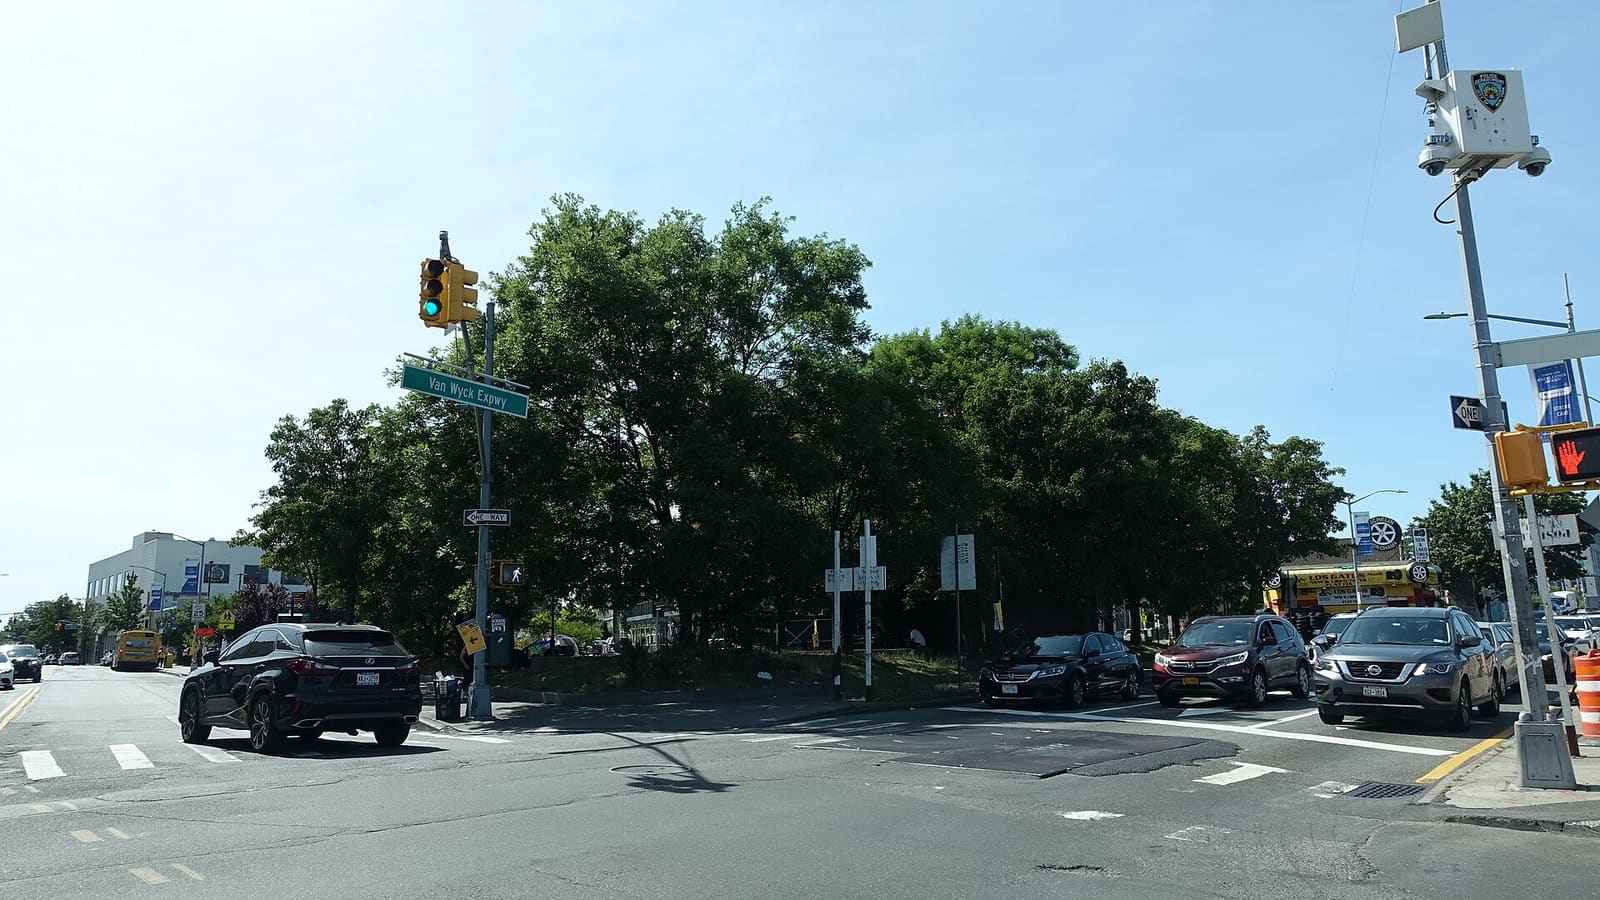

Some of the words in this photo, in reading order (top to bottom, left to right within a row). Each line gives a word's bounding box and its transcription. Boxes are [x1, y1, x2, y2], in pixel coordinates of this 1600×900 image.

[429, 376, 446, 393] Van
[450, 381, 474, 399] Wyck
[477, 389, 507, 409] Expwy
[1461, 406, 1478, 420] ONE
[470, 513, 484, 521] ONE
